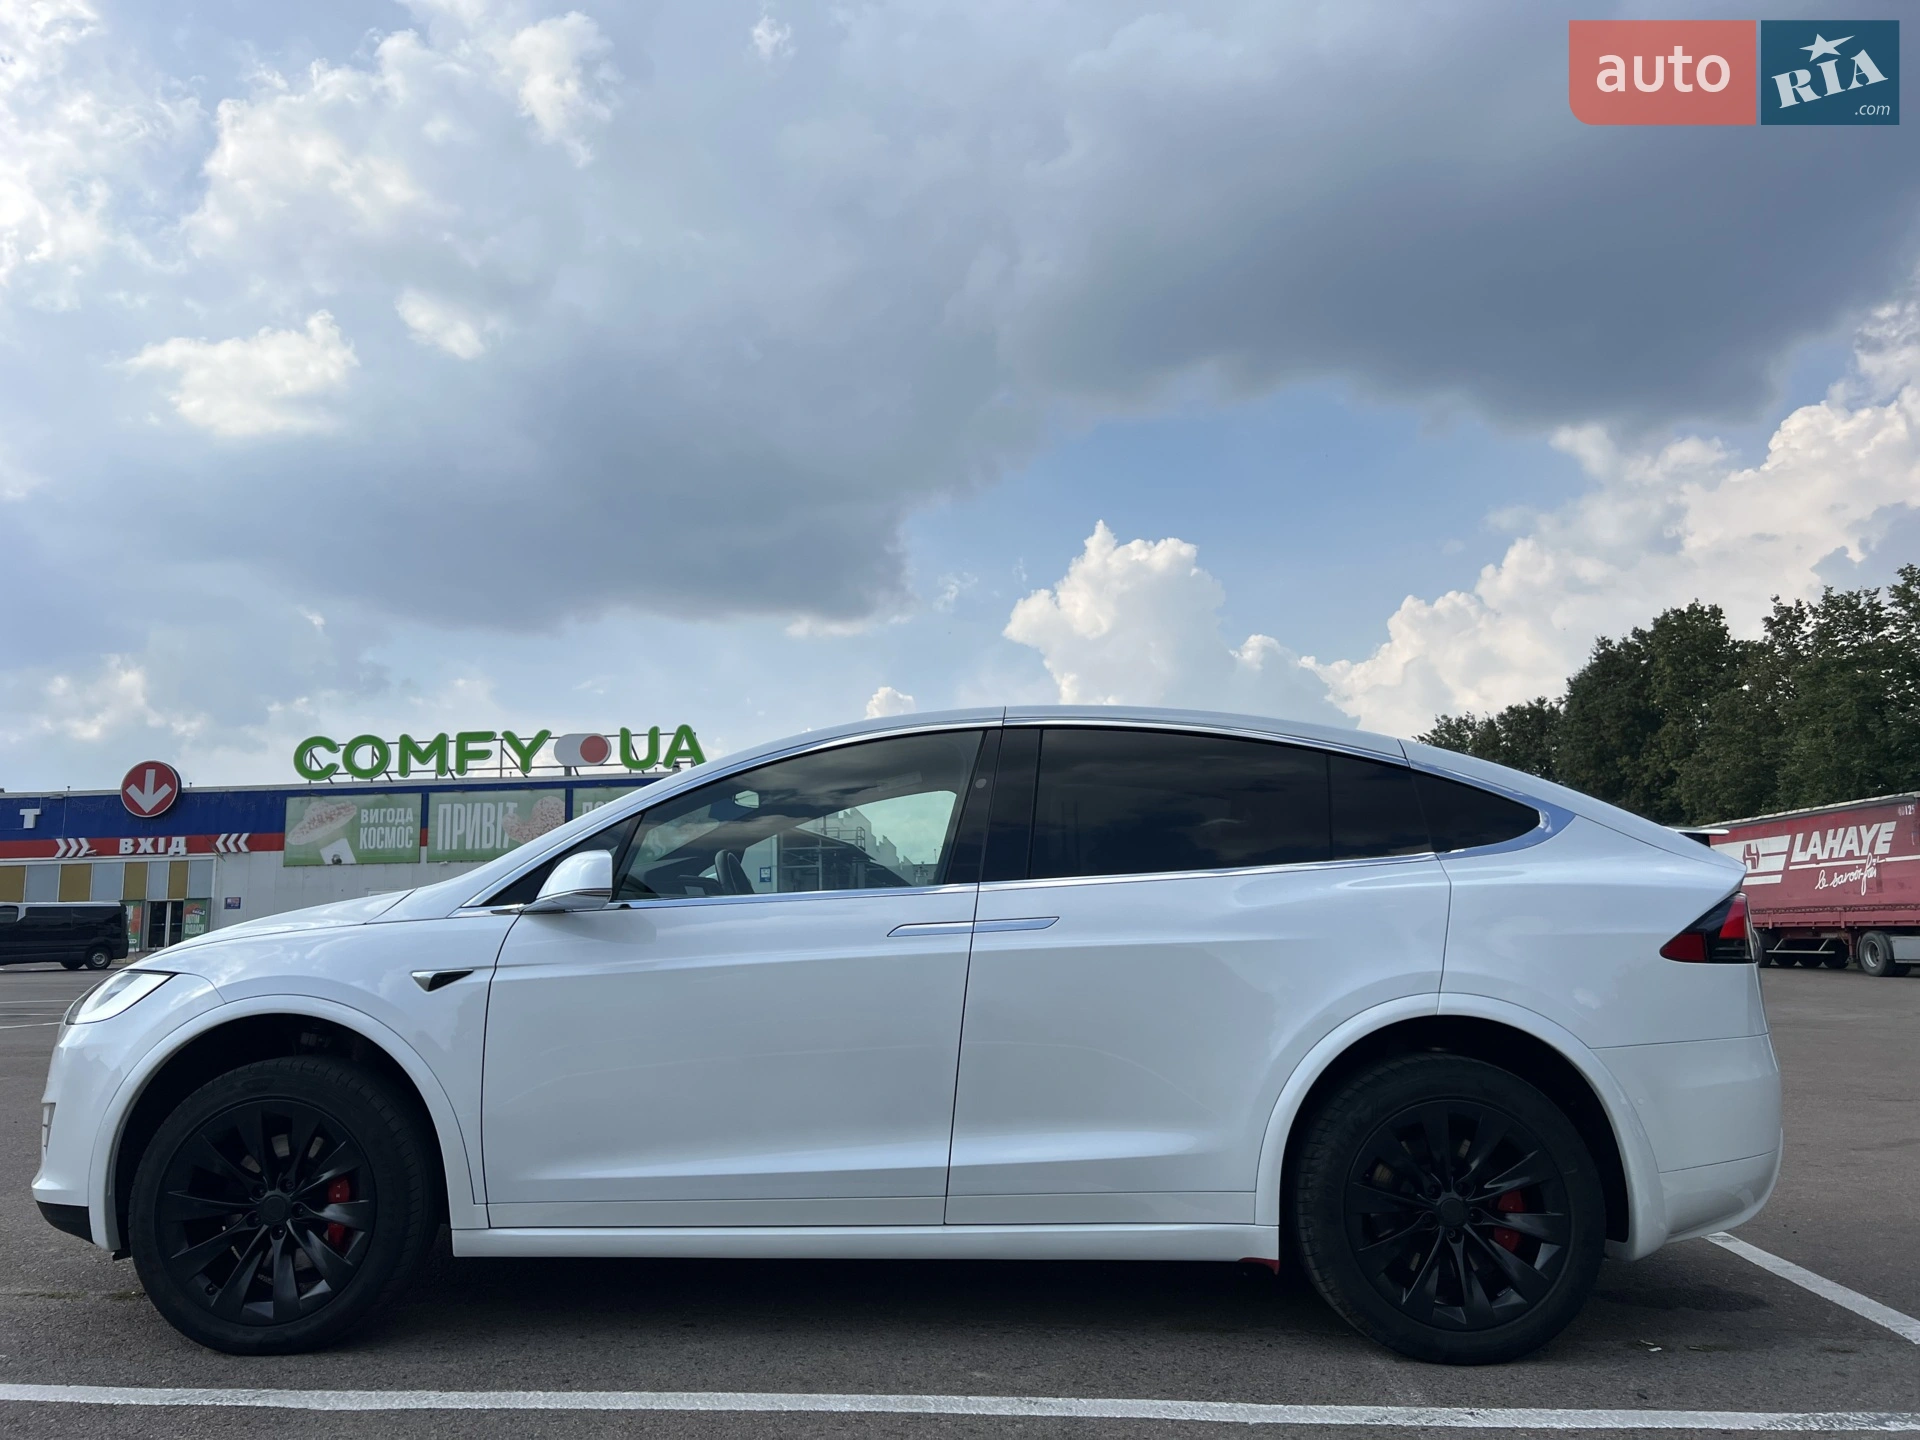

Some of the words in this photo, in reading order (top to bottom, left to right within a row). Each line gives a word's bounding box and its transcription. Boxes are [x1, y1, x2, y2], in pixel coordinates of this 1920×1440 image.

[293, 729, 552, 781] COMFY
[619, 724, 706, 771] UA
[360, 807, 414, 824] ВИГОДА
[437, 802, 518, 850] ПРИВІТ
[119, 836, 188, 856] ВХІД
[359, 826, 414, 850] КОСМОС
[1790, 821, 1897, 862] LAHAYE
